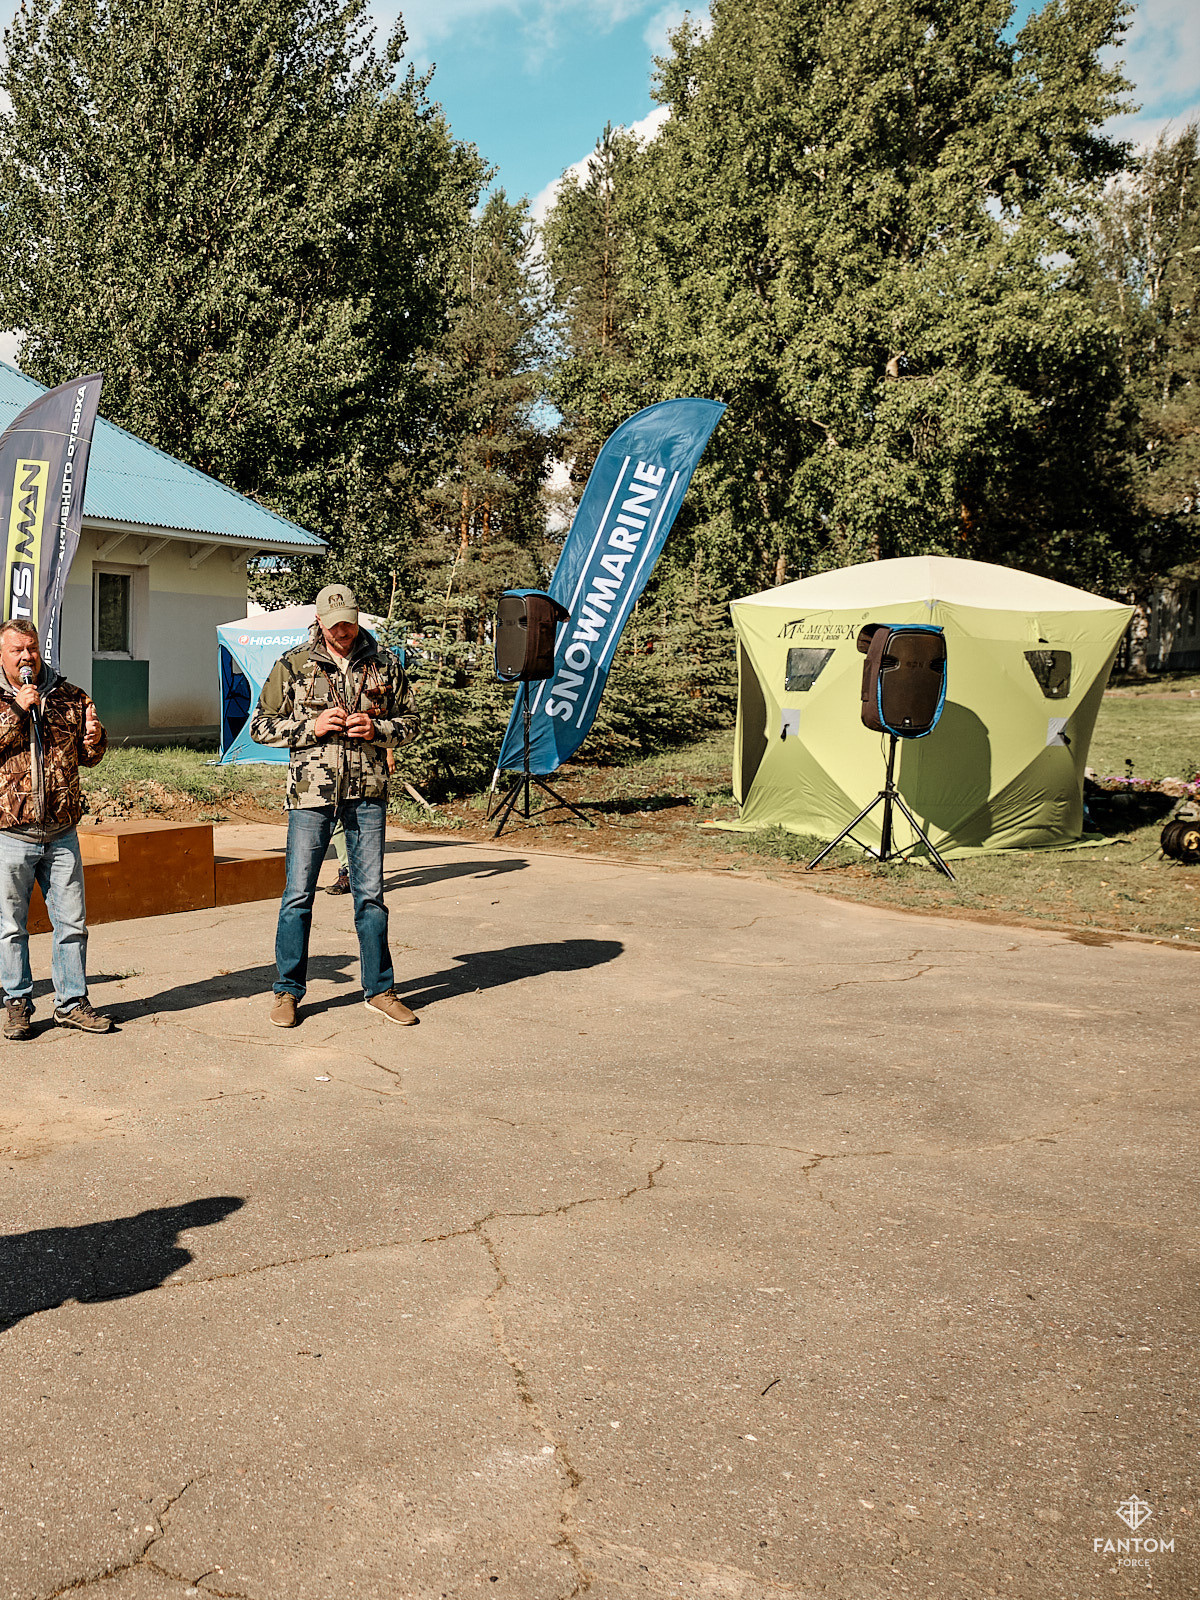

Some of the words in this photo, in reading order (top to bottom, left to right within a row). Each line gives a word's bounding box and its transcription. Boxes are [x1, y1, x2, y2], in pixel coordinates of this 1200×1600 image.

[67, 385, 87, 457] ОТДЫХА
[12, 464, 41, 620] TSMAN
[545, 460, 667, 722] SNOWMARINE
[249, 635, 304, 645] HIGASHI
